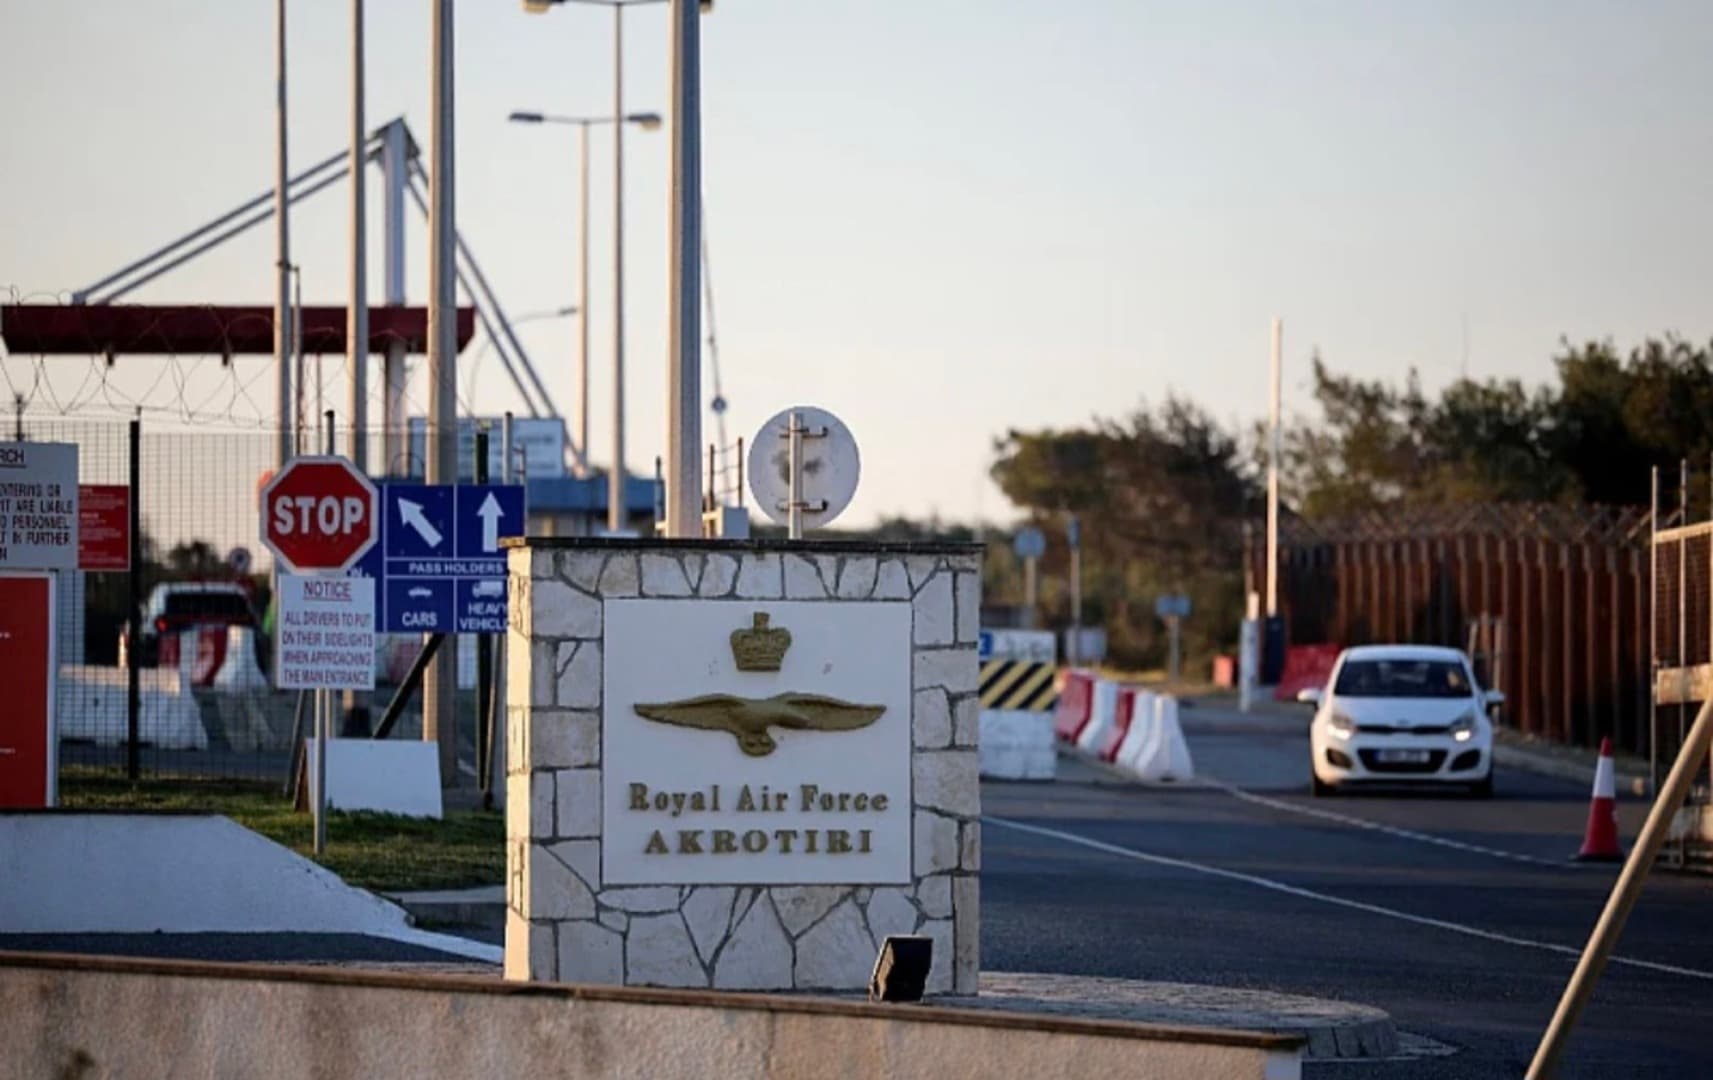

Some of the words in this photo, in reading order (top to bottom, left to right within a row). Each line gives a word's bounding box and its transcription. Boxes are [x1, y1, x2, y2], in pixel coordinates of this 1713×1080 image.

[16, 500, 34, 513] ARE
[41, 500, 73, 514] LIABLE
[275, 495, 364, 535] STOP
[27, 531, 70, 546] FURTHER
[409, 562, 441, 574] PASS
[445, 562, 504, 574] HOLDERS
[304, 581, 351, 598] NOTICE
[285, 611, 301, 626] ALL
[303, 611, 339, 627] DRIVERS
[342, 612, 354, 627] TO
[355, 613, 371, 628] PUT
[402, 611, 438, 627] CARS
[459, 618, 508, 631] VEHICL
[282, 631, 294, 645] ON
[283, 650, 309, 664] WHEN
[284, 669, 300, 684] THE
[302, 669, 323, 684] MAIN
[325, 669, 369, 685] ENTRANCE
[629, 783, 721, 817] Royal
[736, 784, 789, 812] Air
[800, 784, 890, 812] Force
[645, 829, 873, 854] AKROTIRI
